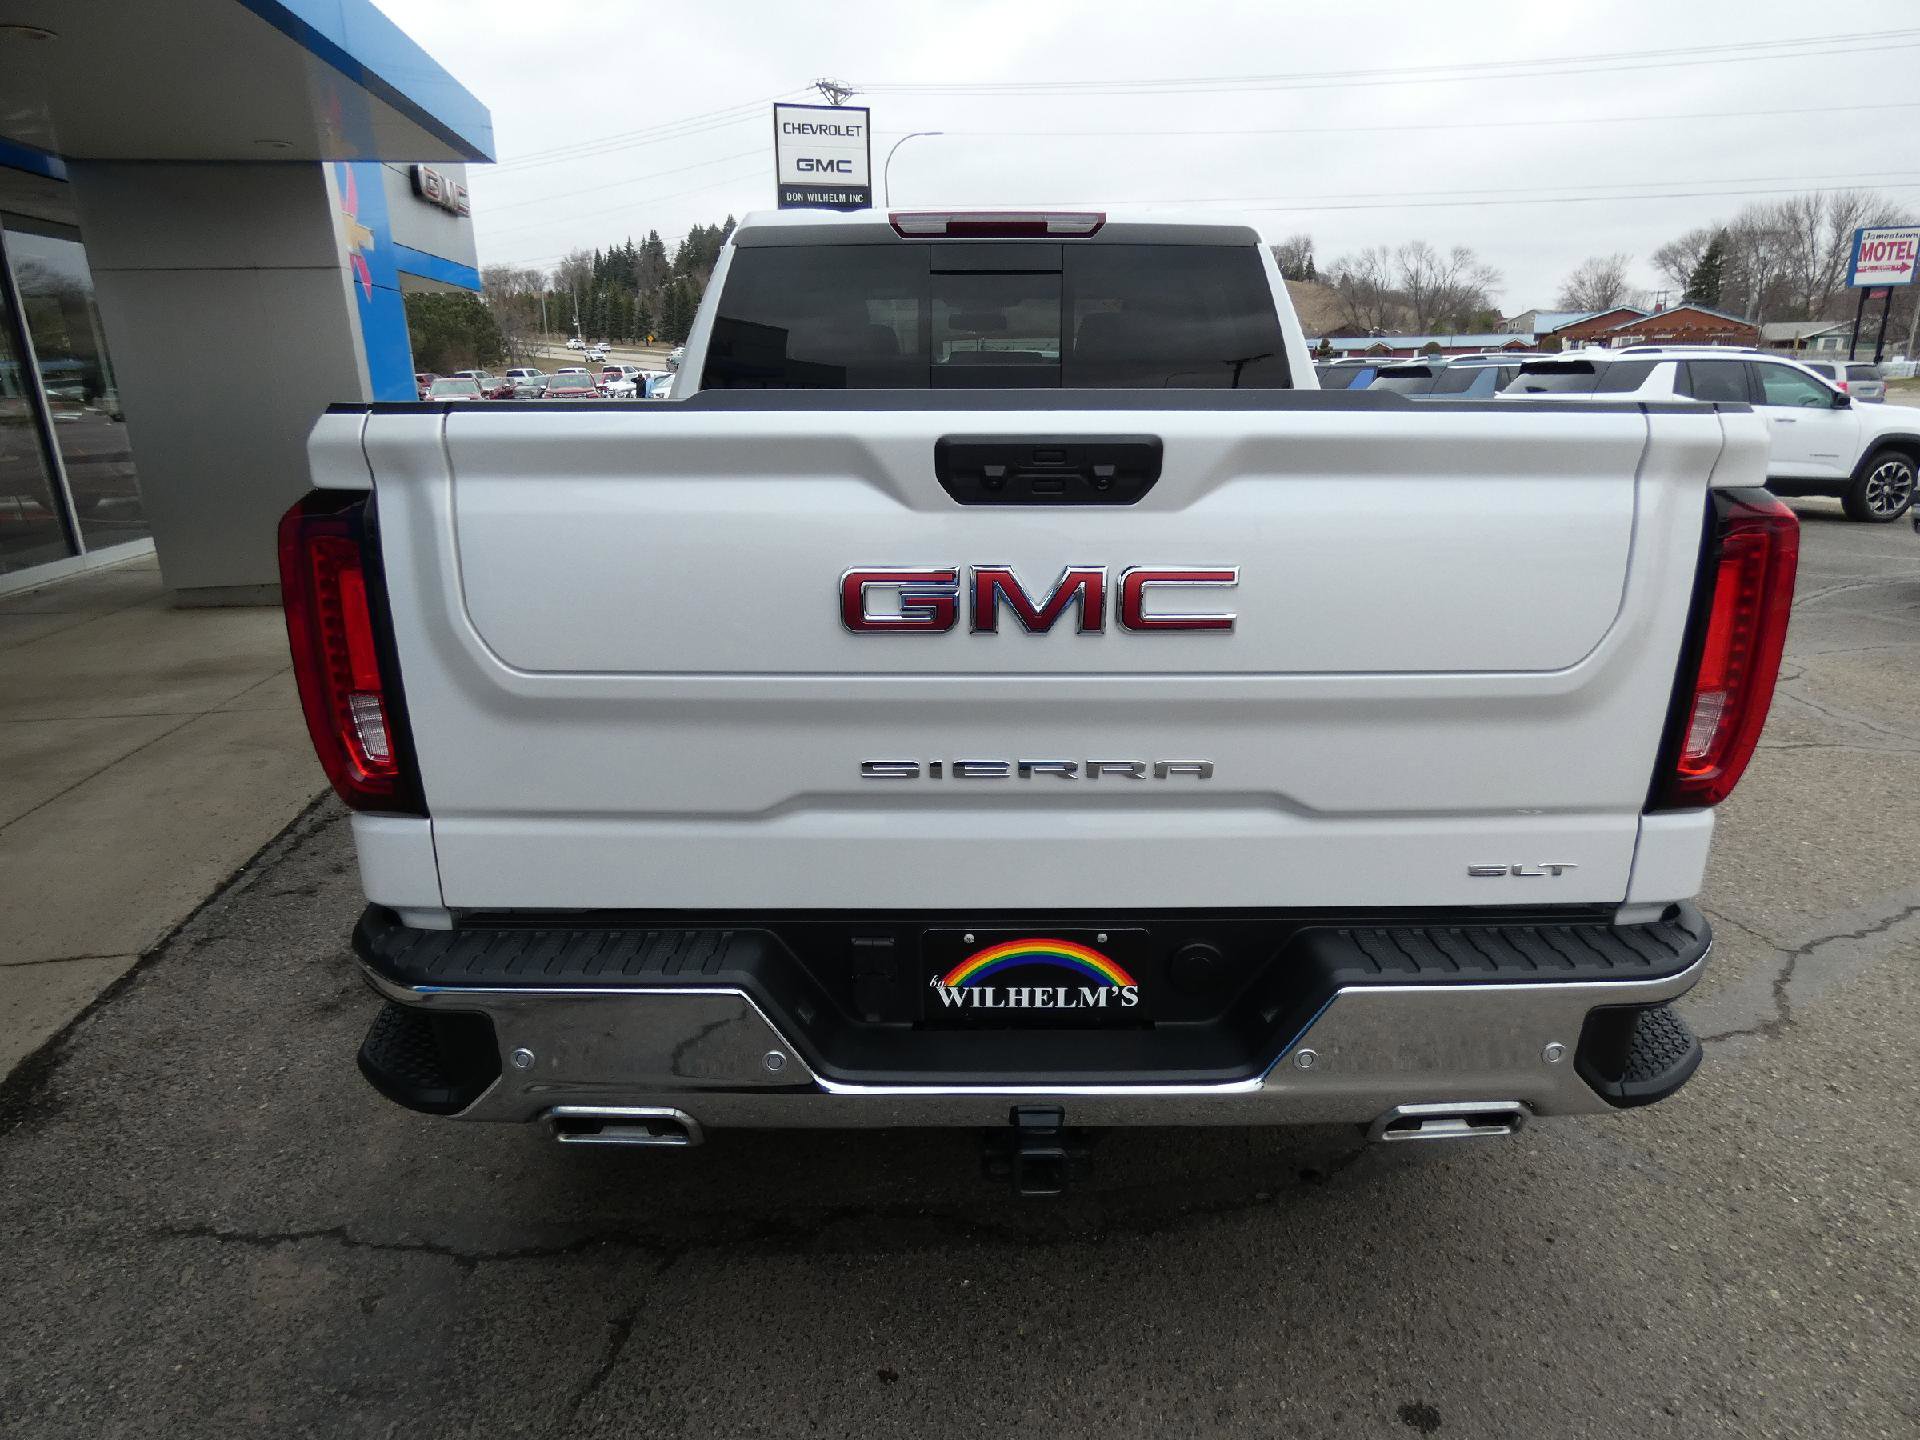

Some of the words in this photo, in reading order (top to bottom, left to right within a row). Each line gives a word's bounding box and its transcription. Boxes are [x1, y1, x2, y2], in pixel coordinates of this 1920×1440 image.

[783, 122, 862, 137] CHEVROLET
[796, 158, 852, 174] GMC
[418, 163, 471, 218] GMC
[786, 192, 803, 202] DON
[807, 193, 847, 203] WILHELM
[849, 194, 864, 203] INC
[1858, 241, 1915, 262] MOTEL
[838, 564, 1241, 635] GMC
[861, 759, 1215, 780] SIERRA
[1467, 862, 1579, 876] SLT
[937, 985, 1139, 1008] WILHELM'S
